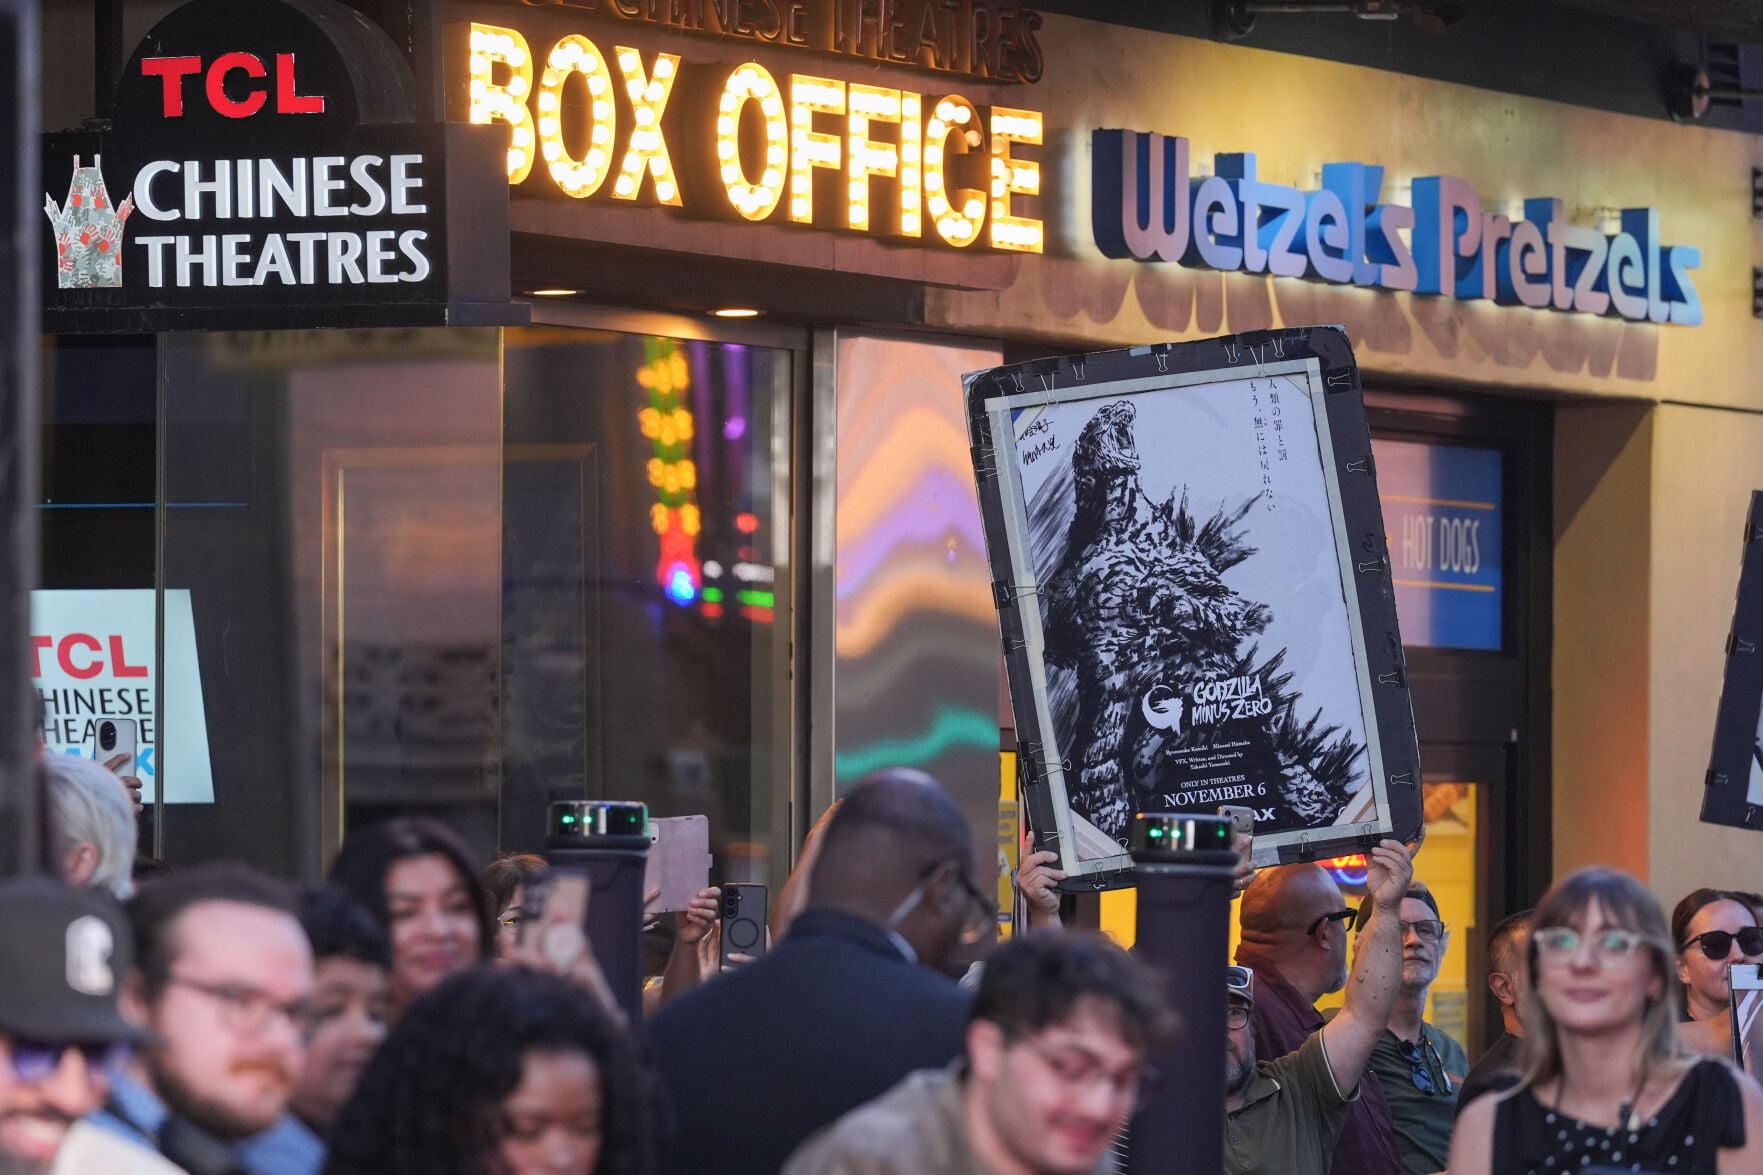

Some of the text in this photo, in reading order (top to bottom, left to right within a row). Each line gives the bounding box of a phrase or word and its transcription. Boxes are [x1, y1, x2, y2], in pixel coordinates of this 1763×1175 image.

[141, 52, 325, 118] TCL
[470, 22, 1044, 254] BOX OFFICE
[133, 154, 427, 221] CHINESE
[135, 229, 430, 287] THEATRES
[1411, 175, 1703, 326] Pretzels
[1402, 514, 1481, 574] HOT DOGS
[38, 687, 153, 715] HINESE
[1193, 674, 1263, 704] GODZILLA
[40, 718, 155, 744] HEAE
[1192, 698, 1272, 727] MINUS ZERO
[1162, 782, 1266, 808] NOVEMBER 6
[1180, 774, 1246, 789] ONLY IN THEATRES
